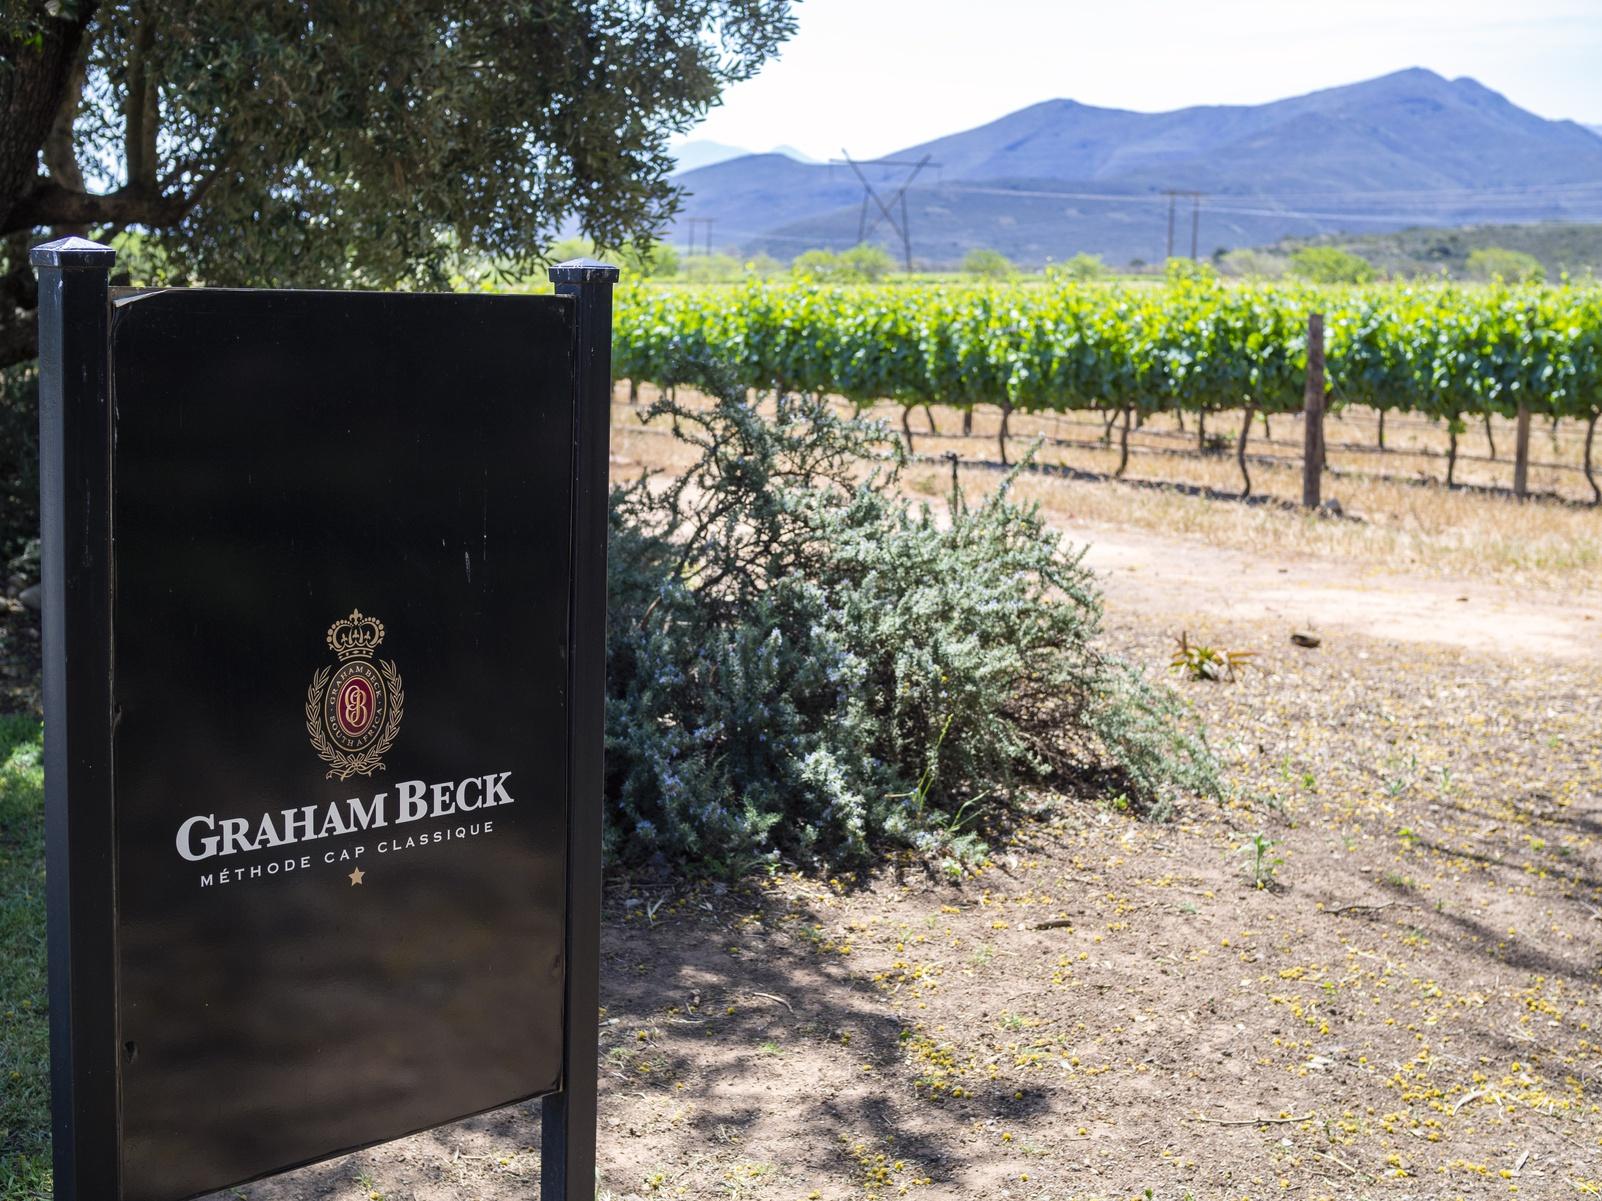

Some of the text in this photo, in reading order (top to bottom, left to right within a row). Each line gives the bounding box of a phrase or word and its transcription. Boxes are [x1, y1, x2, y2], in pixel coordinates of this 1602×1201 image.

[329, 665, 382, 705] GRAHAM BECK
[329, 707, 383, 747] SOUTH AFRICA
[175, 771, 515, 862] GRAHAM BECK
[200, 821, 494, 888] MÉTHODE CAP CLASSIQUE
